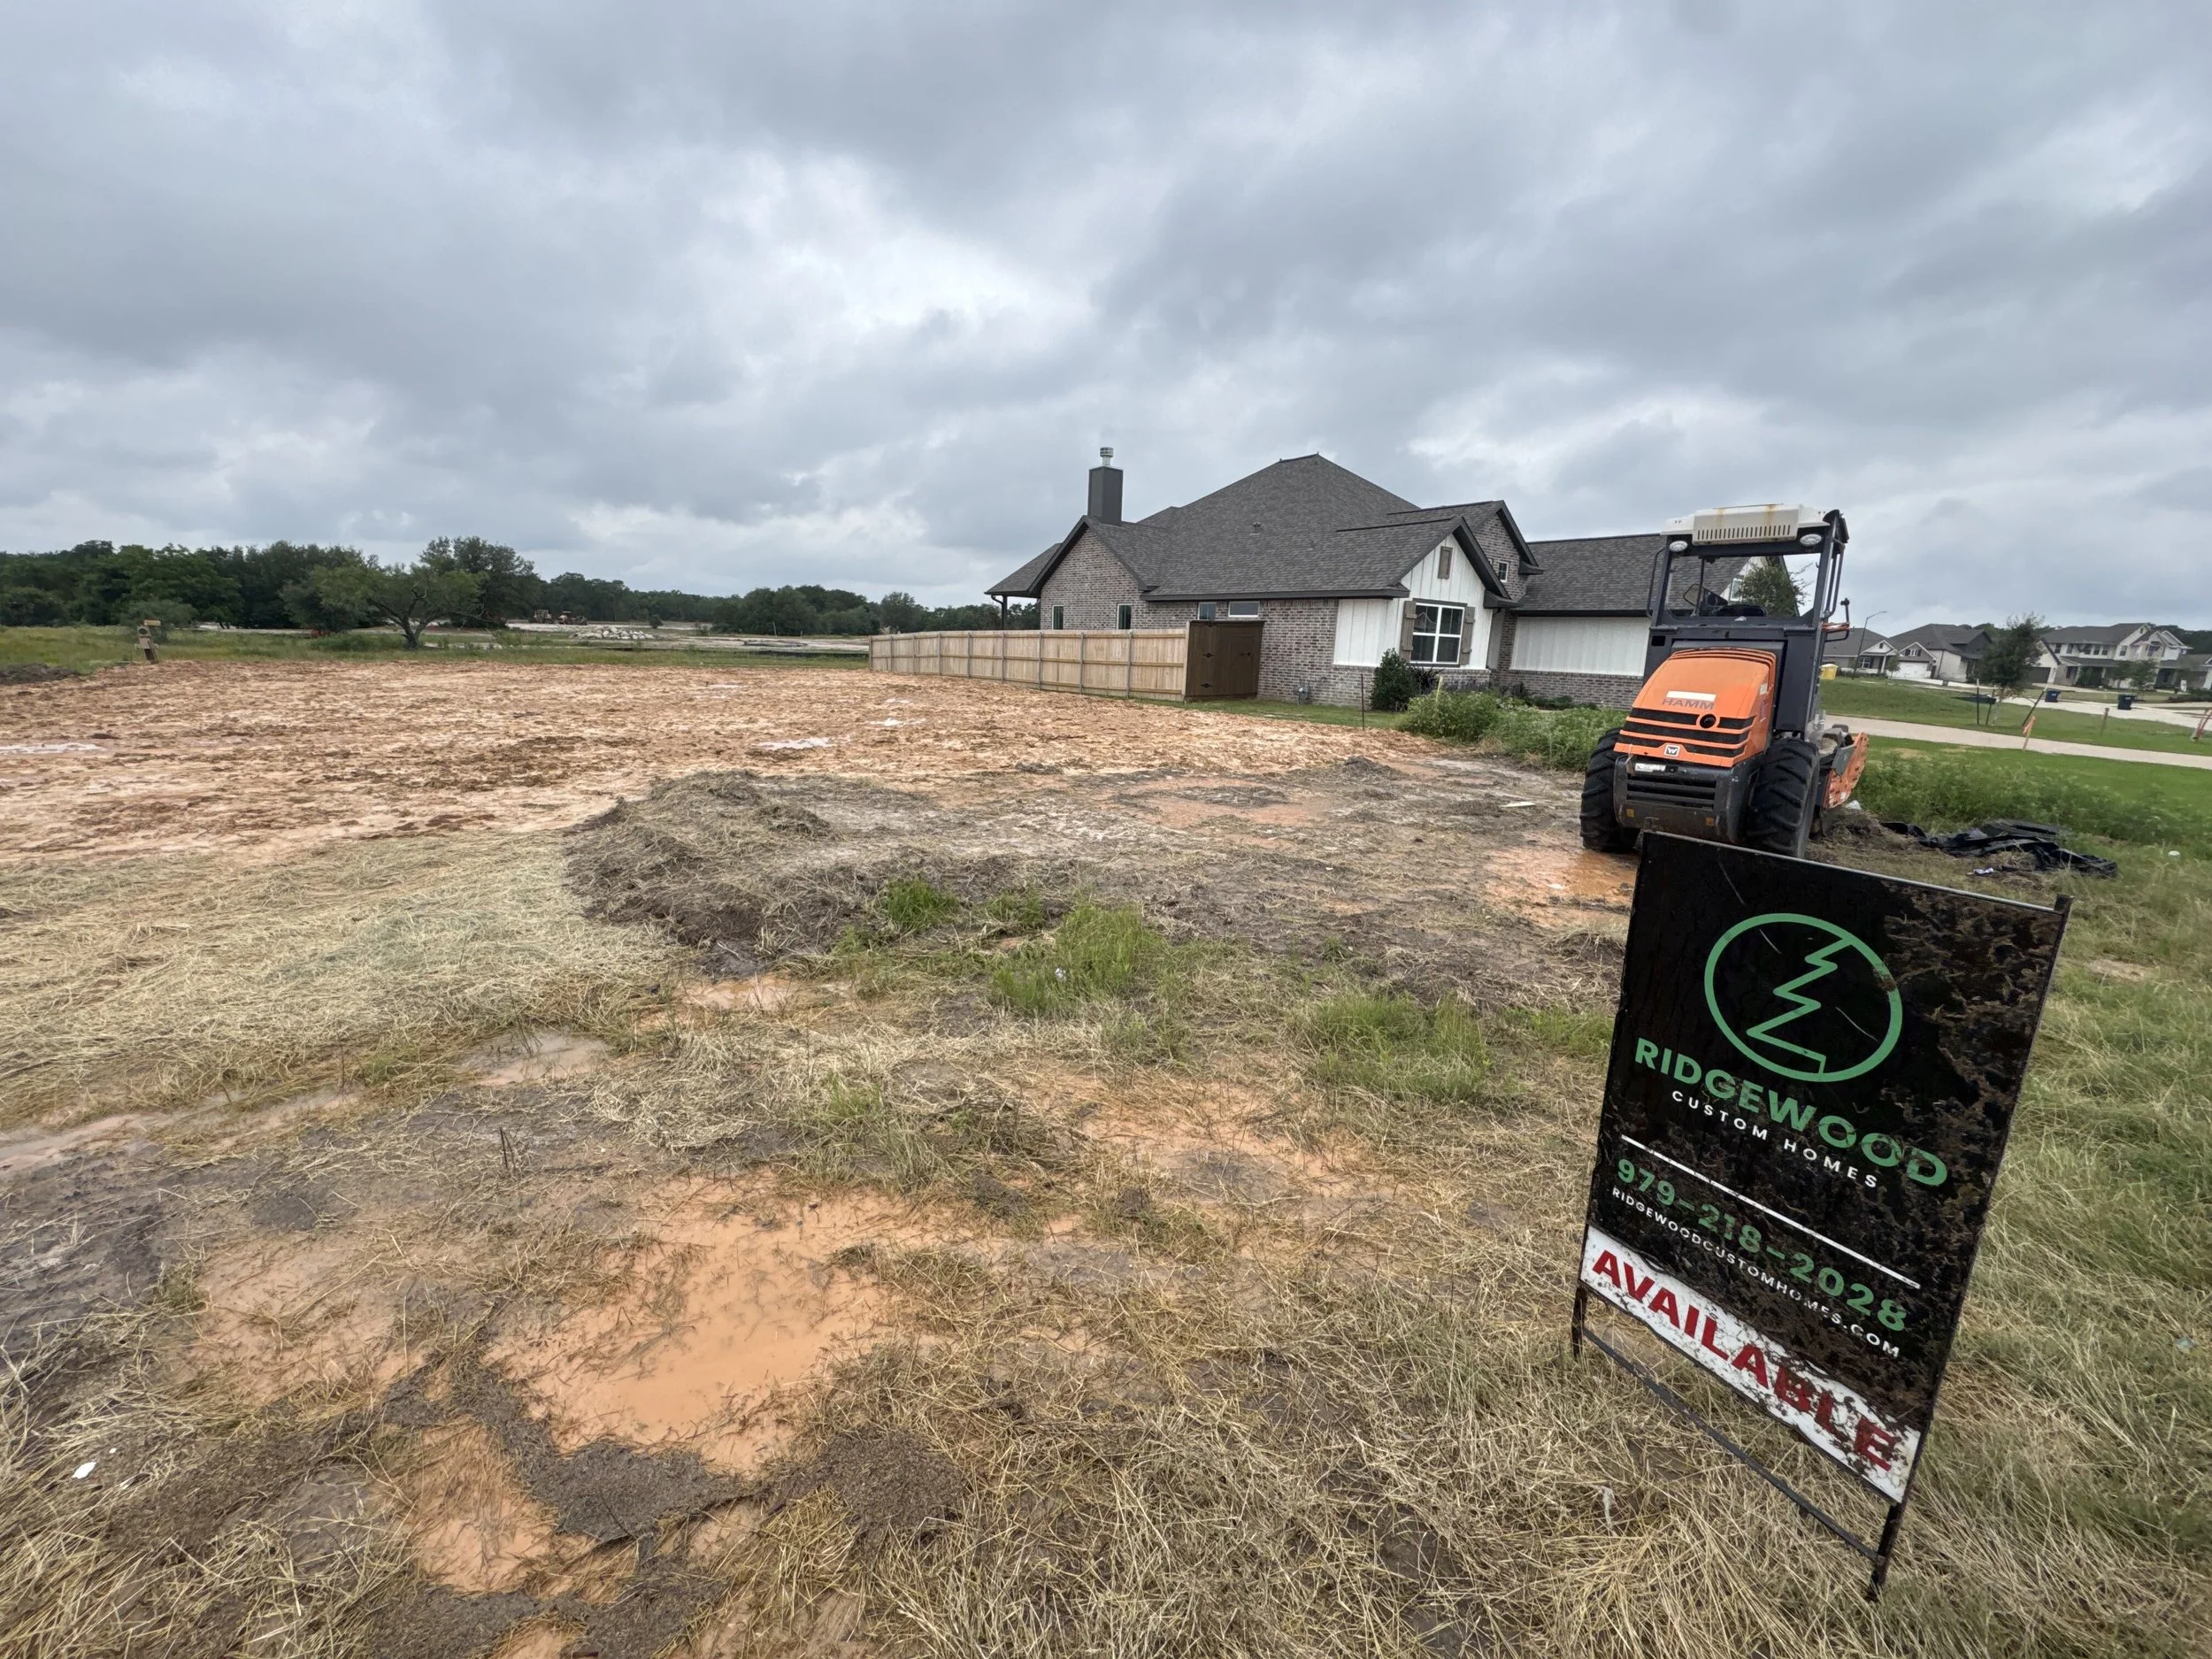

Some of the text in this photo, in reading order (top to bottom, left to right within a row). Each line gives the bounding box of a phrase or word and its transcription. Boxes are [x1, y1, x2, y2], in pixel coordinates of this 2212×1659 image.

[1662, 697, 1715, 710] HAMM
[1635, 1037, 1948, 1187] RIDGEWOOD
[1671, 1089, 1878, 1188] CUSTOM HOMES
[1611, 1187, 1901, 1357] RIDGEWOODCUSTOMHOMES.COM
[1617, 1157, 1908, 1333] 979-218-2028
[1591, 1248, 1899, 1471] AVAILABLE
